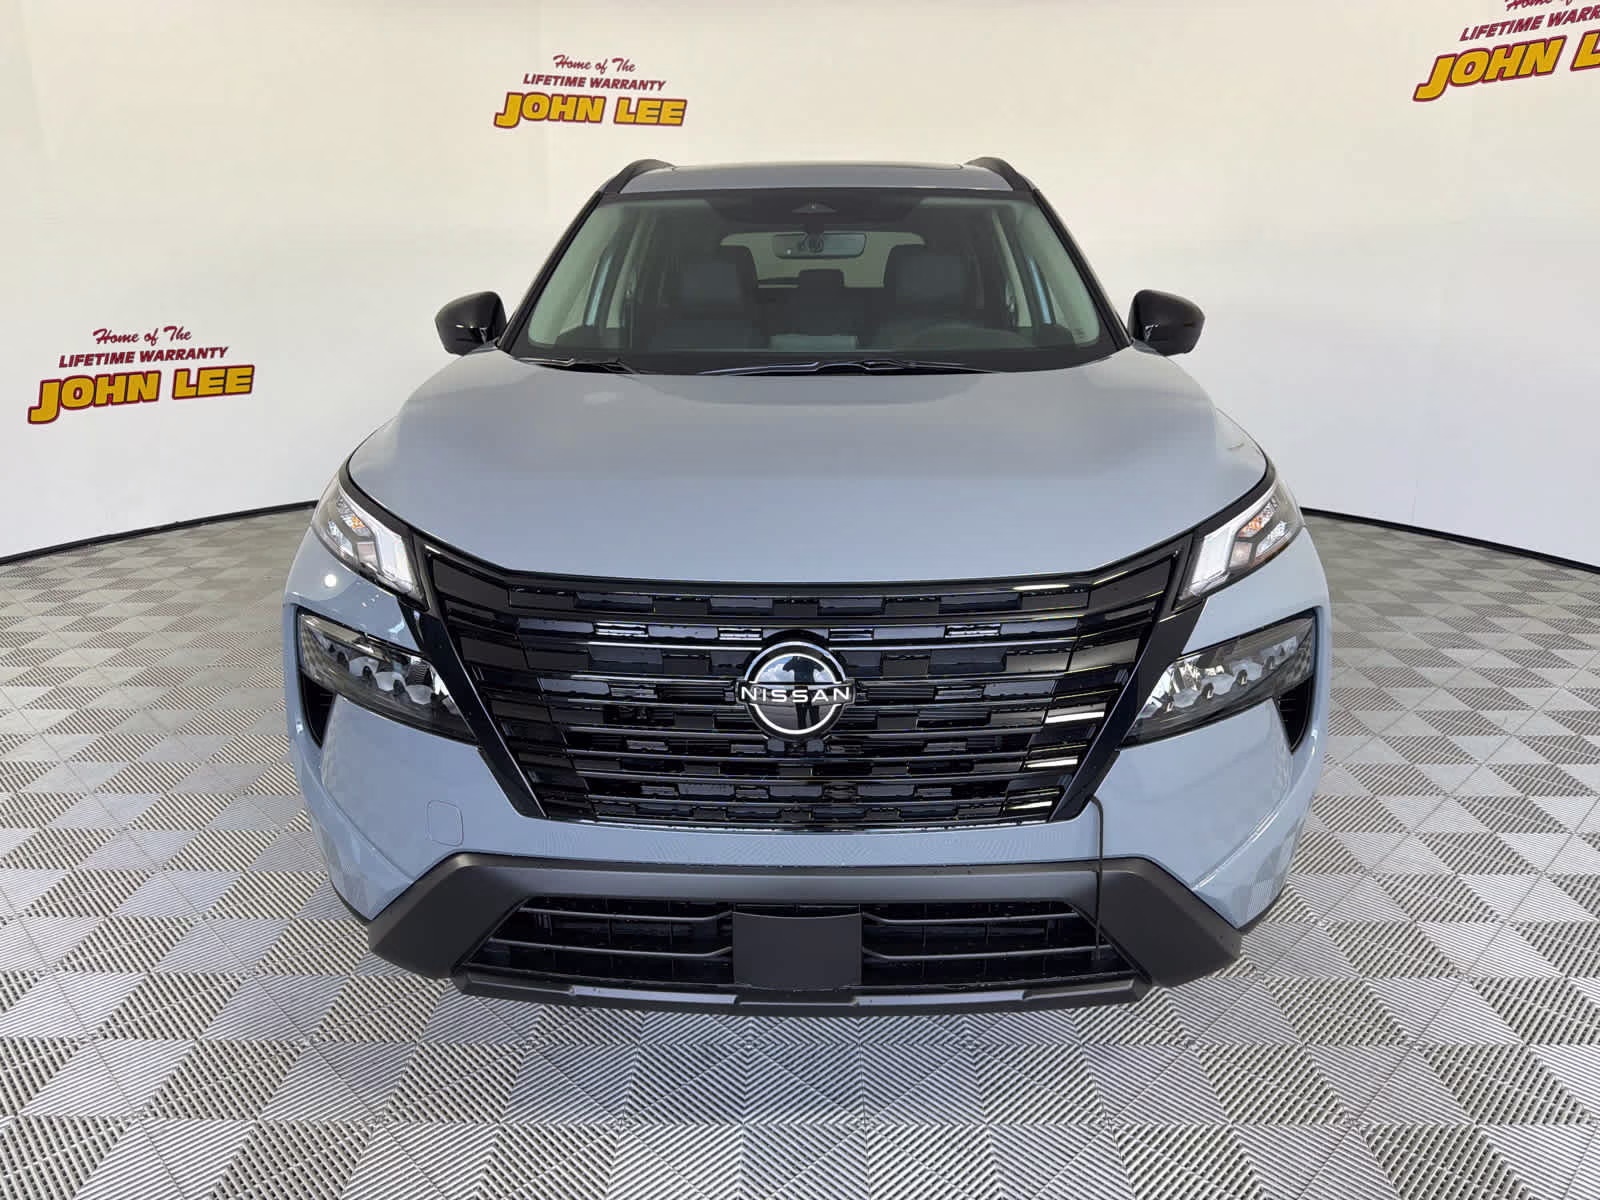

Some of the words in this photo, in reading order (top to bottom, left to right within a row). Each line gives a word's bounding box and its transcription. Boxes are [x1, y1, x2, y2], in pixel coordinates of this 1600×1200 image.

[1460, 15, 1545, 42] LIFETIME
[553, 54, 591, 70] Home
[594, 58, 608, 73] of
[612, 57, 636, 72] The
[1413, 35, 1567, 102] JOHN
[523, 73, 586, 87] LIFETIME
[590, 77, 667, 91] WARRANTY
[494, 91, 607, 129] JOHN
[613, 96, 688, 126] LEE
[92, 328, 139, 344] Home
[144, 328, 158, 346] of
[163, 325, 192, 342] The
[59, 351, 135, 368] LIFETIME
[139, 346, 229, 363] WARRANTY
[28, 371, 161, 424] JOHN
[172, 364, 255, 400] LEE
[741, 686, 850, 703] NISSAN
